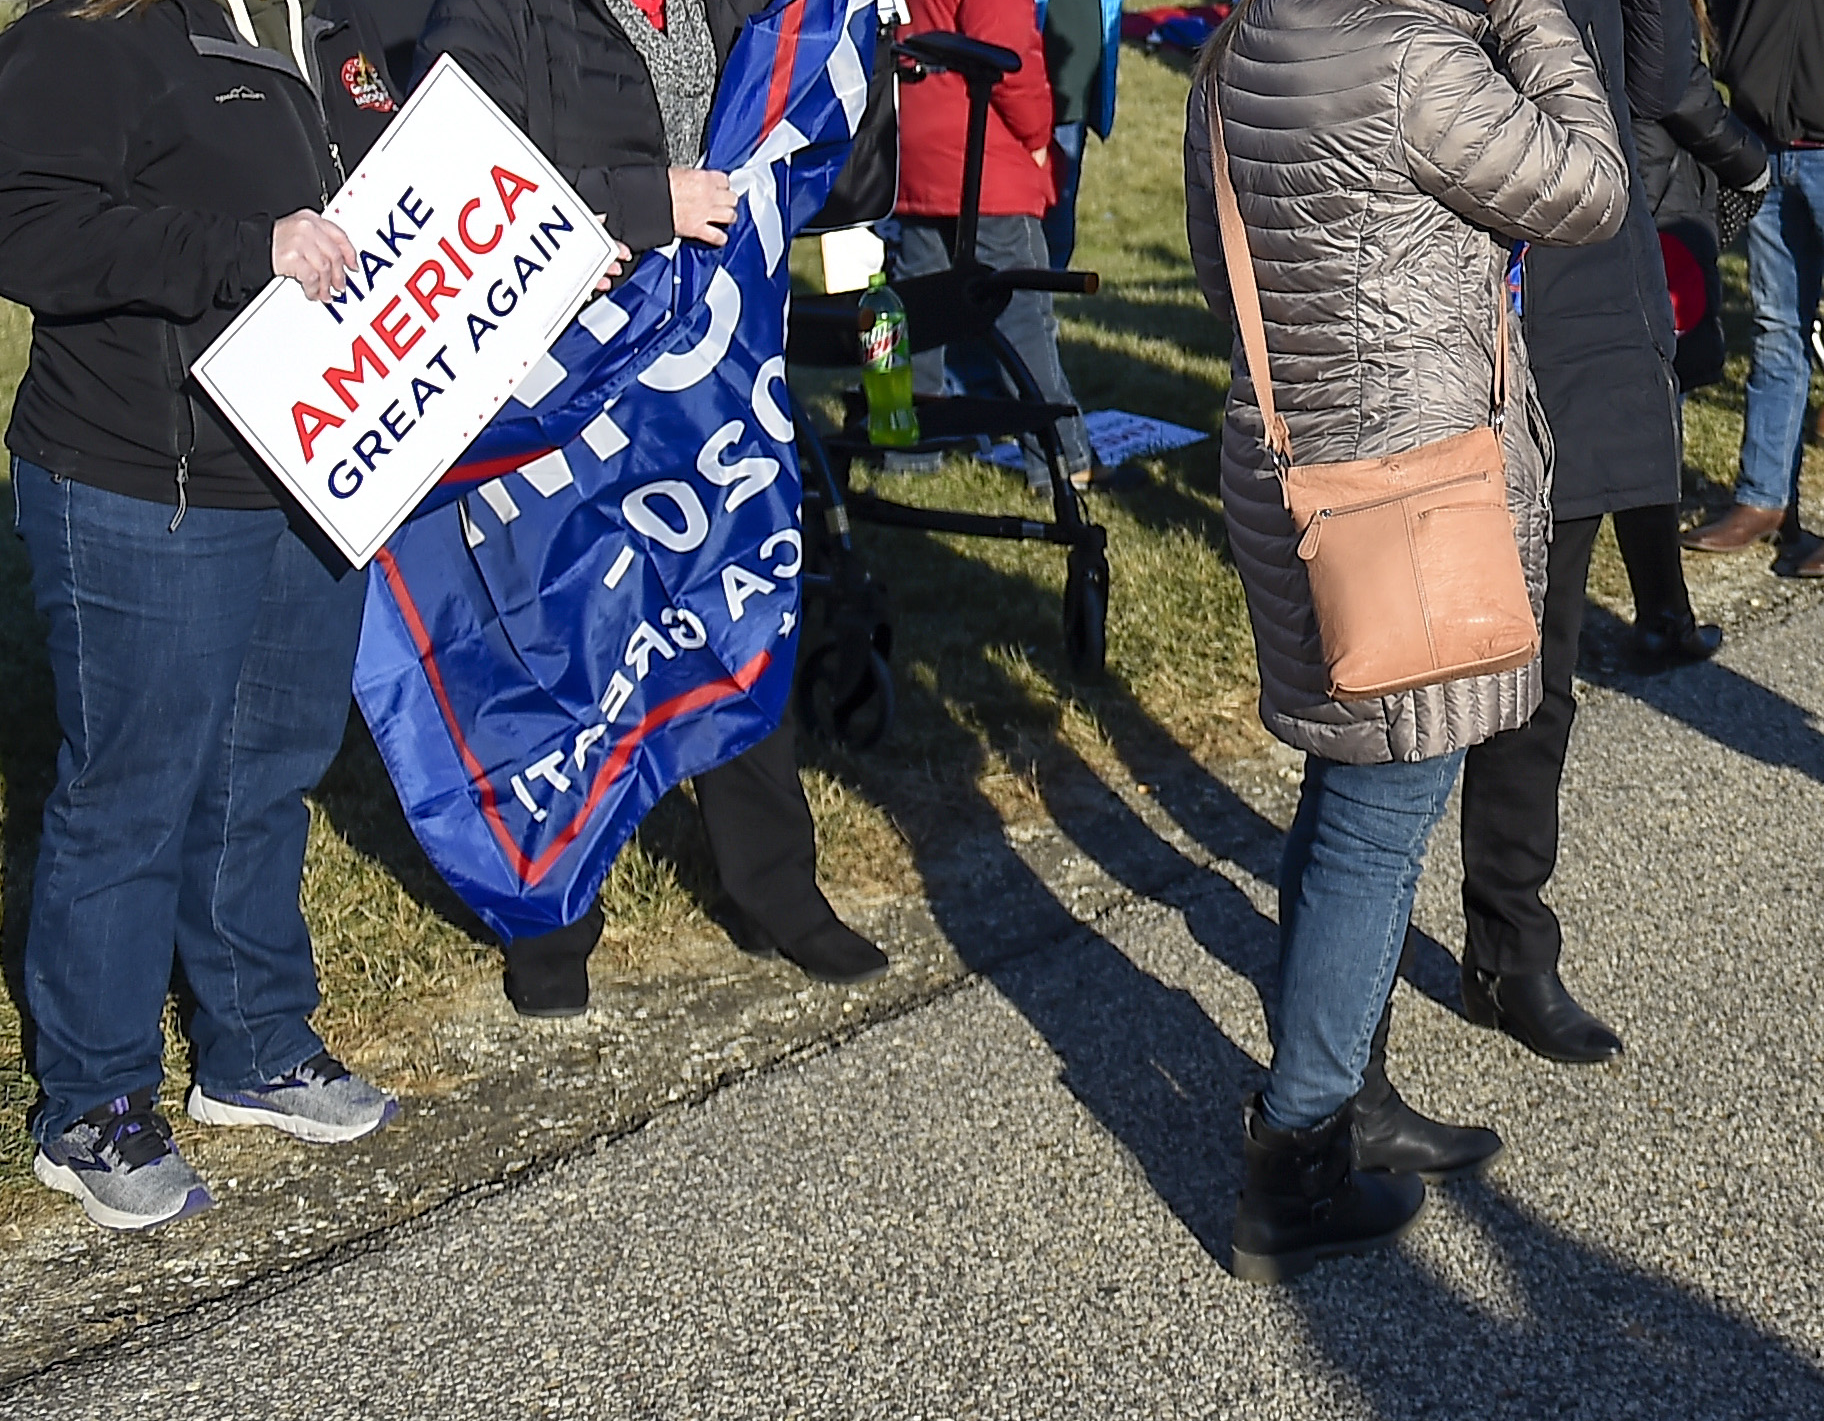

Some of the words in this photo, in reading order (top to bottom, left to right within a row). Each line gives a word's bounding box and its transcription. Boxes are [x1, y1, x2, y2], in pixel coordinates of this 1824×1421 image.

[291, 165, 539, 464] AMERICA
[322, 186, 434, 324] MAKE
[328, 345, 457, 499] GREAT
[467, 205, 574, 353] AGAIN
